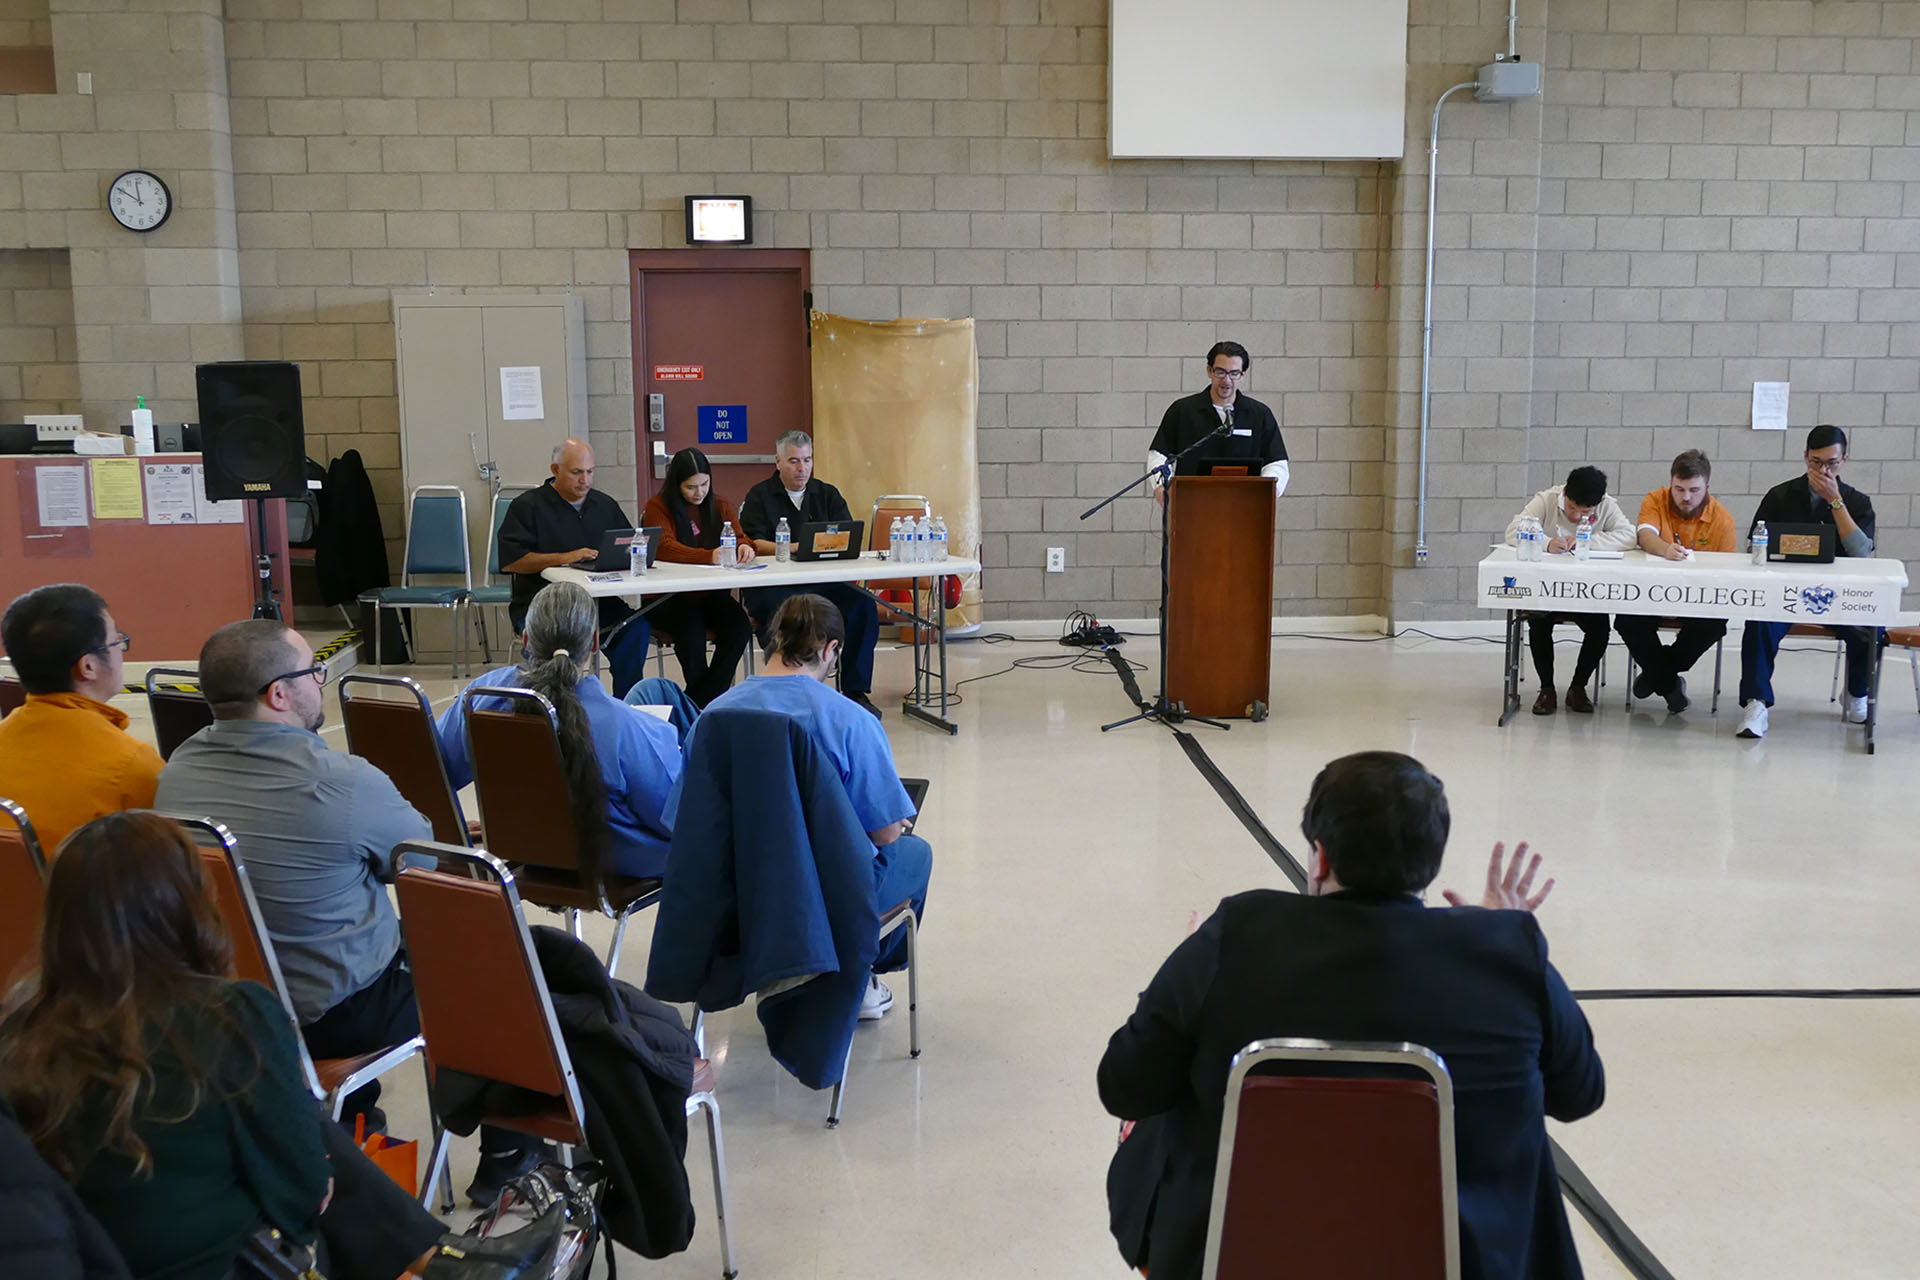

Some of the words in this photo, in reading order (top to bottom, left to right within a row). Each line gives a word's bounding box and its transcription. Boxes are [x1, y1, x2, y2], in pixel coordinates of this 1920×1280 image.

[138, 218, 144, 226] 6
[717, 409, 728, 418] DO
[716, 421, 730, 429] NOT
[713, 431, 733, 440] OPEN
[243, 483, 271, 492] YAMAHA
[1538, 580, 1641, 601] MERCED
[1648, 584, 1766, 607] COLLEGE
[1842, 588, 1874, 598] Honor
[1841, 601, 1878, 613] Society
